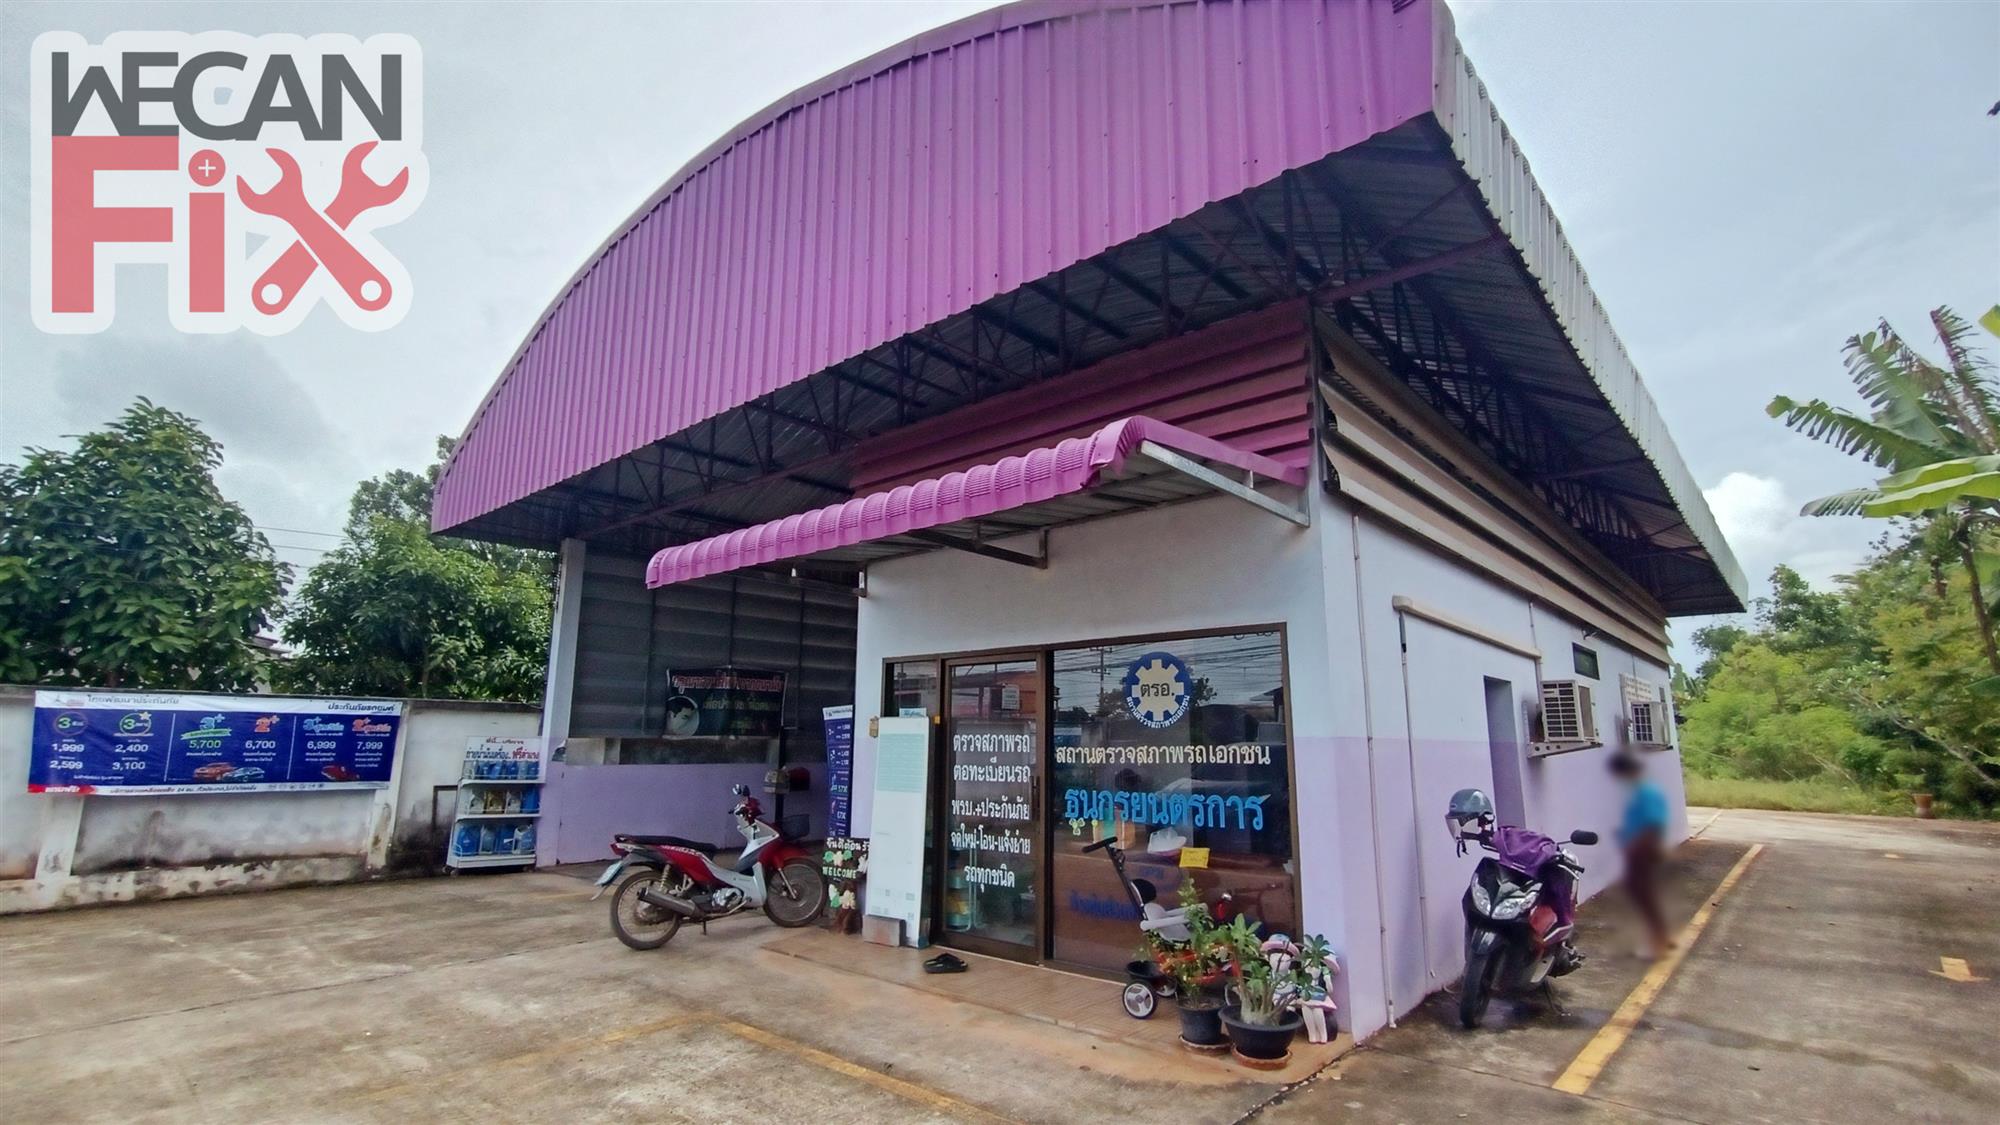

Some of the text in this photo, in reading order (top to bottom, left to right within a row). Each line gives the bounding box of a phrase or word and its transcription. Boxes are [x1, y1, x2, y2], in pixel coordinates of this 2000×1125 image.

[1140, 683, 1175, 697] ตรอ.
[328, 702, 395, 711] ประกันภัยรถยนต์
[58, 717, 71, 728] 3
[123, 718, 135, 730] 3
[51, 743, 85, 752] 1,999
[189, 740, 221, 749] 5,700
[245, 740, 276, 749] 6,700
[307, 741, 336, 750] 6,999
[356, 741, 383, 750] 7,999
[953, 734, 1030, 752] ตรวจสภาพรถ
[115, 744, 149, 753] 2,400
[1055, 745, 1270, 766] สถานตรวจสภาพรถเอกชน
[49, 760, 83, 769] 2,599
[112, 761, 146, 770] 3,100
[1065, 788, 1263, 832] ธนกรยนตรการ
[822, 866, 857, 879] WELCOME
[964, 863, 1015, 893] รถทุกชนิด
